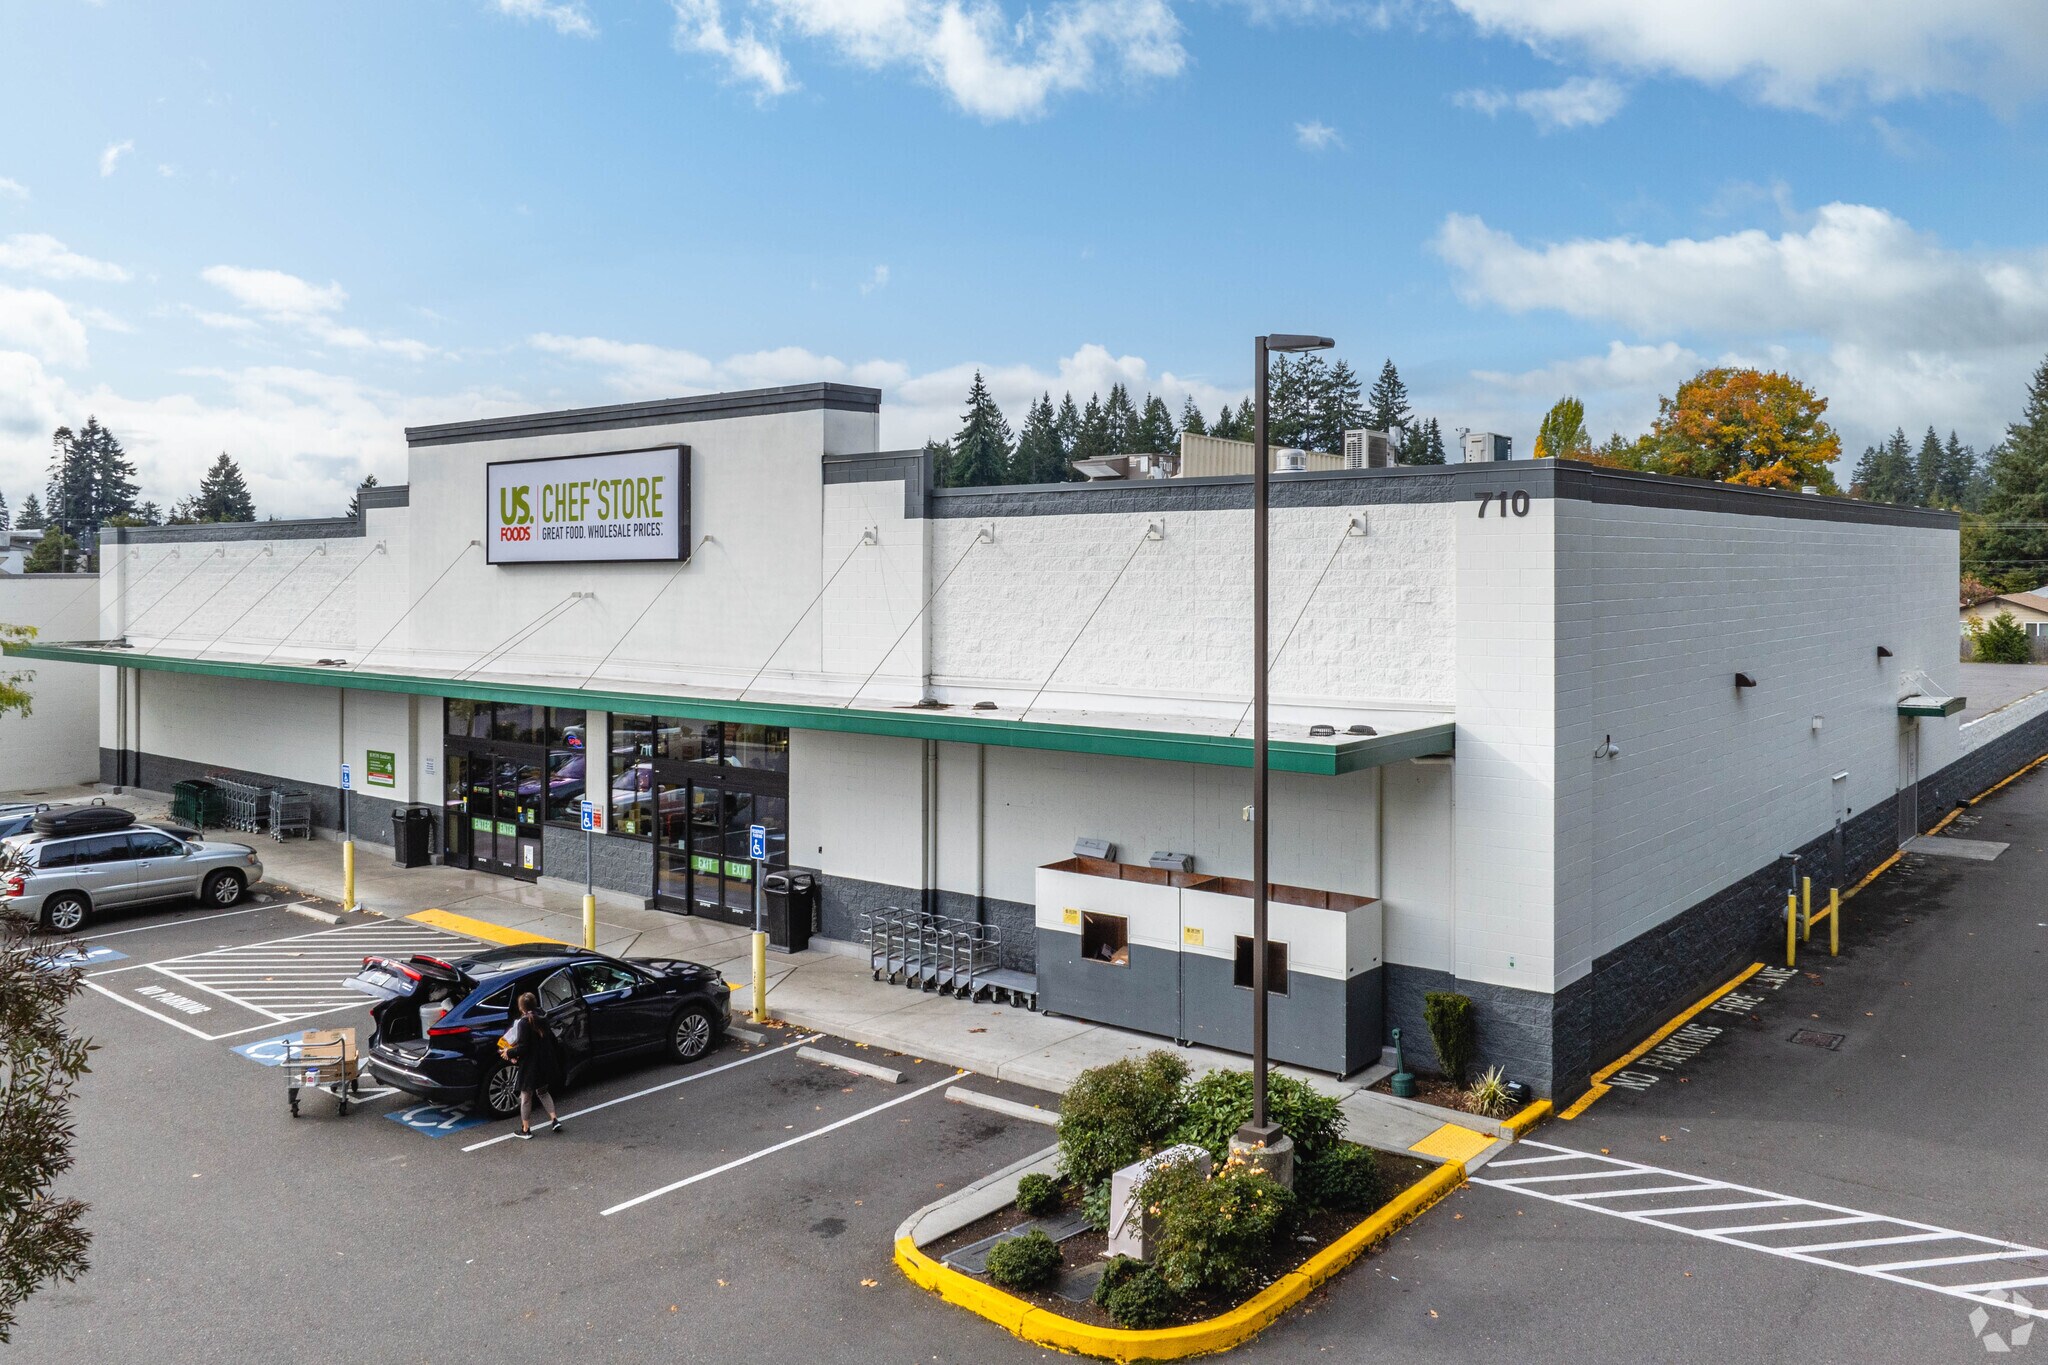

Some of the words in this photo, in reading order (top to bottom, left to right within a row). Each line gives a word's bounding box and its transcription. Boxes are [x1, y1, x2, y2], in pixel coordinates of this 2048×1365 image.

[1474, 491, 1530, 518] 710
[500, 526, 531, 542] FOODS
[542, 526, 564, 541] GREAT
[566, 525, 587, 540] FOOD.
[588, 523, 632, 539] WHOLESALE
[633, 522, 664, 537] PRICES.
[475, 819, 491, 831] ENTER
[500, 823, 516, 836] ENTER
[698, 856, 713, 870] EXIT
[732, 863, 748, 876] EXIT
[134, 985, 167, 995] NO
[150, 992, 212, 1015] PARKING
[1608, 1071, 1659, 1091] NO
[1637, 1023, 1723, 1071] PARKING
[1710, 992, 1765, 1015] FIRE
